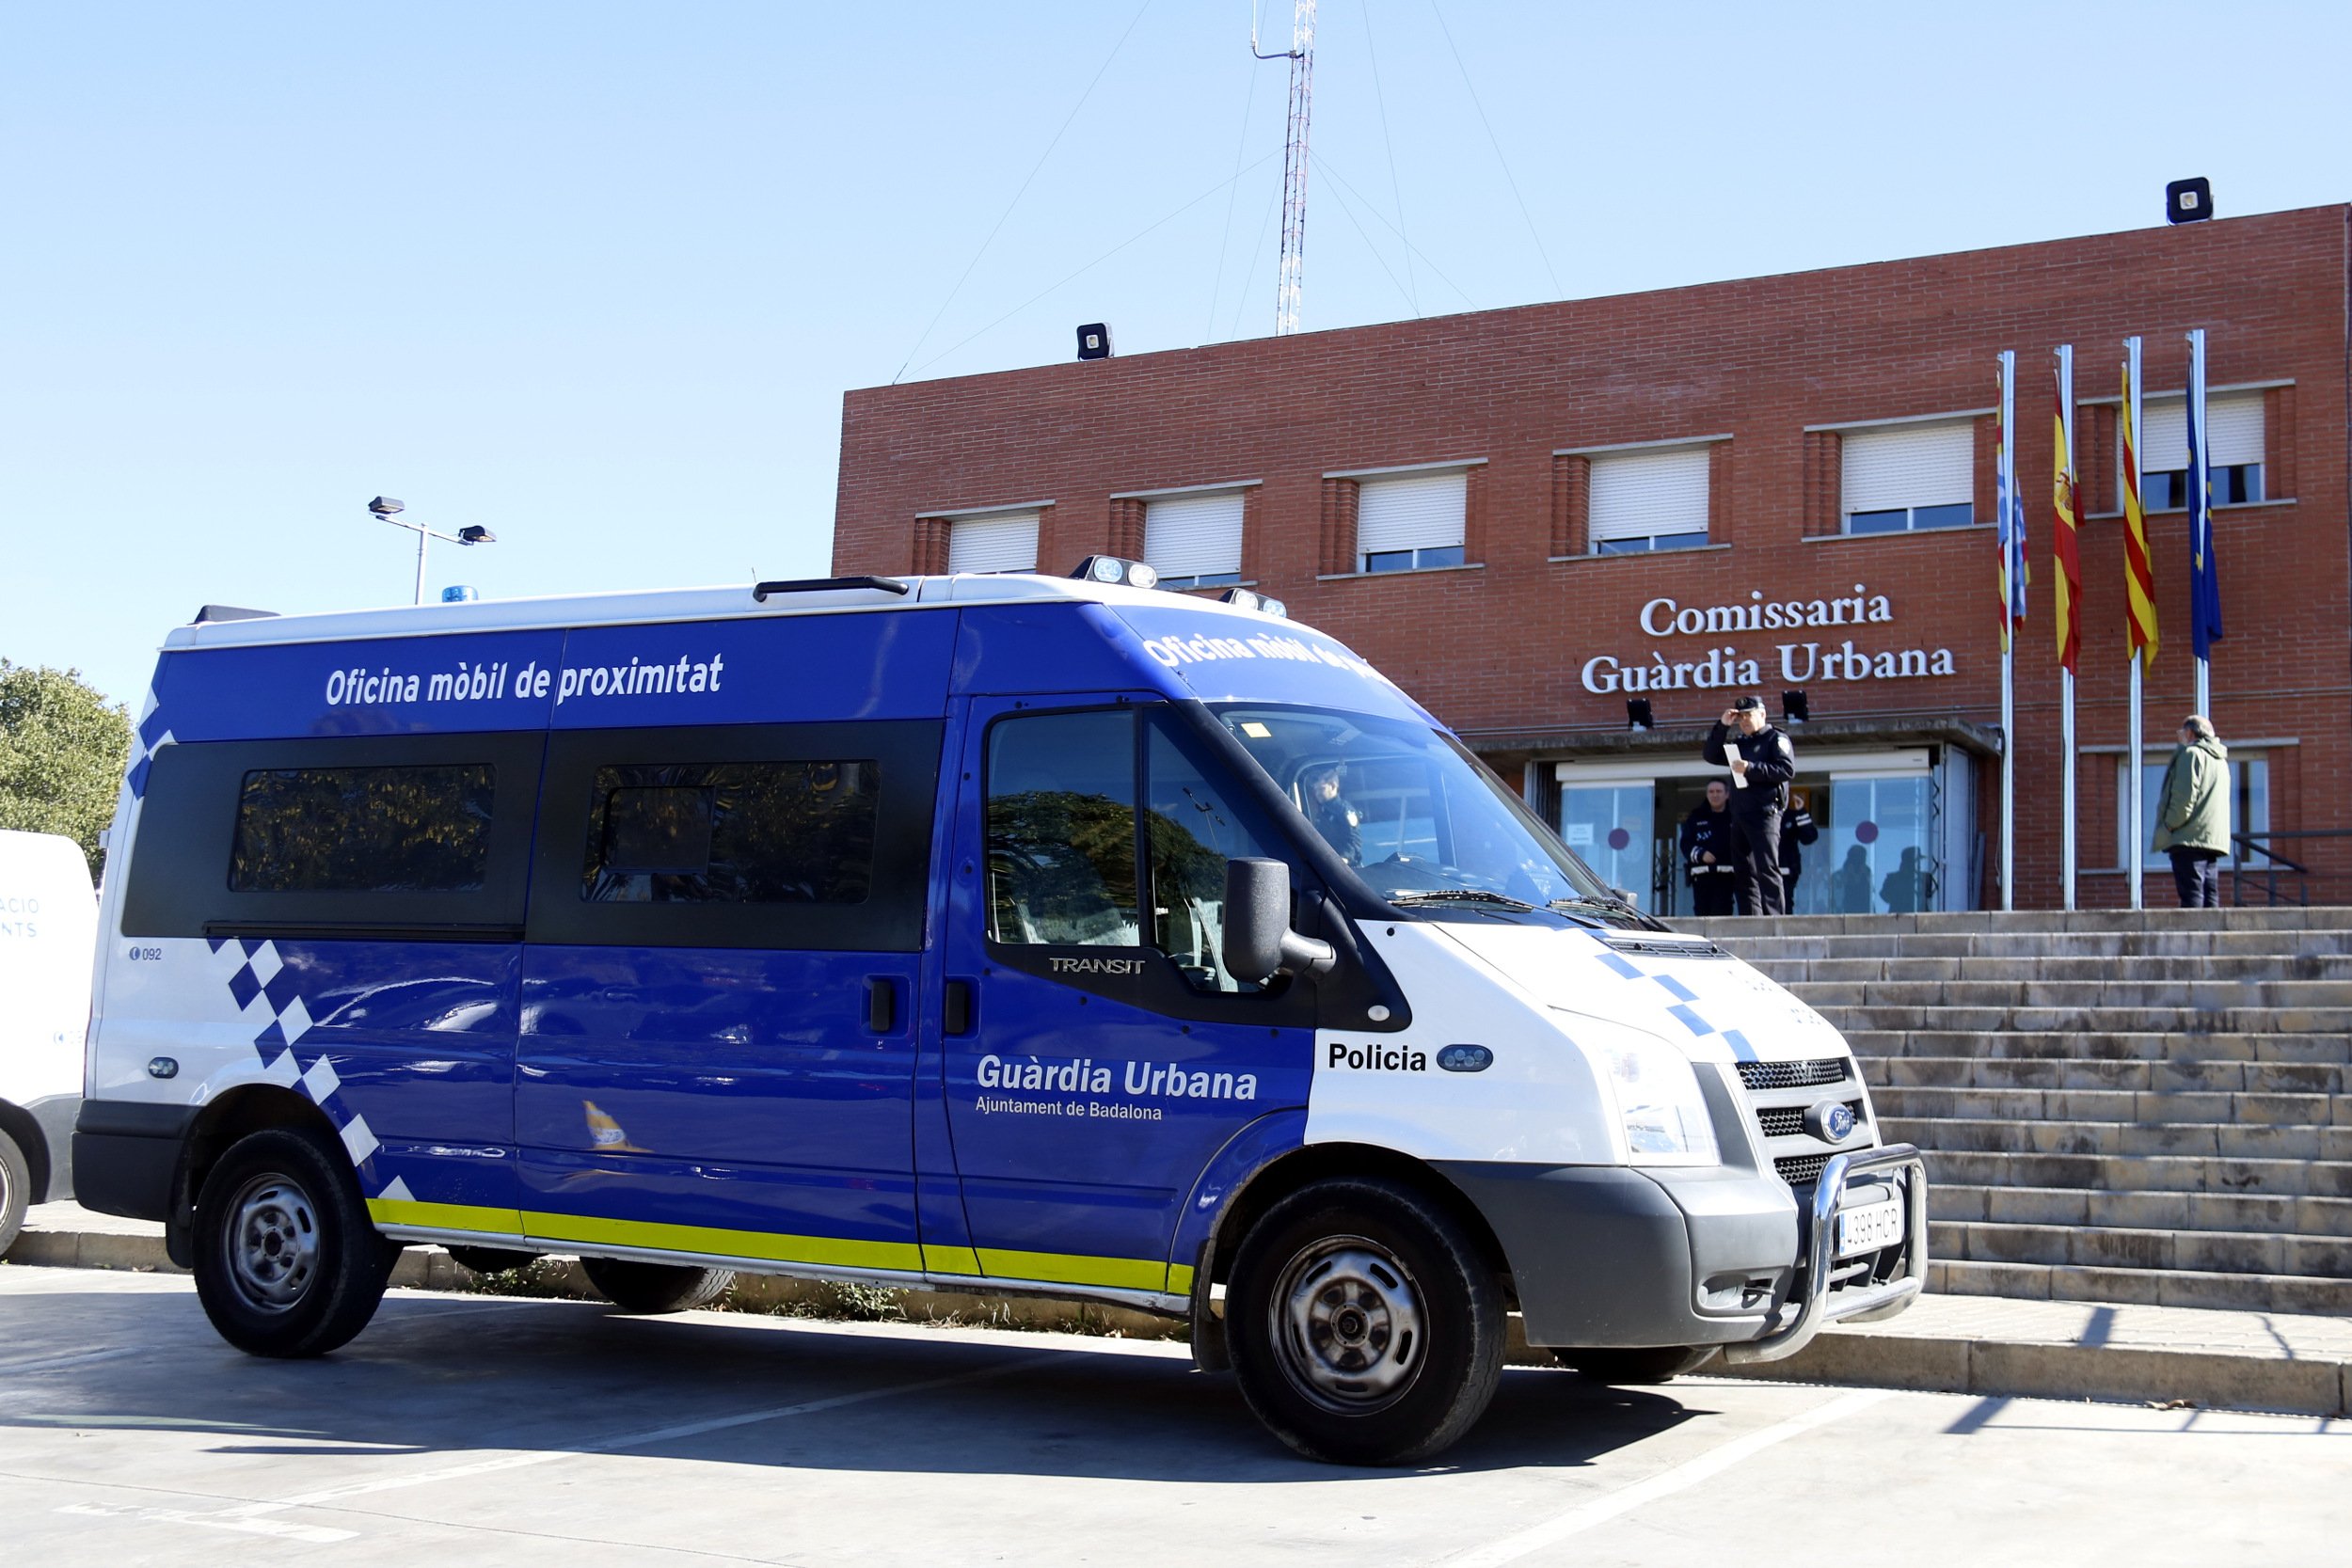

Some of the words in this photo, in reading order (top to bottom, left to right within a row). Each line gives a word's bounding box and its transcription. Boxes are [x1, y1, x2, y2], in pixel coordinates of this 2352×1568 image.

[1640, 583, 1894, 637] Comissaria
[1143, 633, 1255, 667] Oficina
[326, 666, 419, 705] Oficina
[427, 661, 508, 702] mòbil
[515, 660, 550, 699] de
[557, 653, 723, 706] proximitat
[1581, 646, 1762, 694] Guàrdia
[1775, 641, 1956, 683] Urbana
[142, 947, 162, 960] 092
[1049, 958, 1146, 974] TRANSIT
[1328, 1043, 1427, 1071] Policia
[977, 1054, 1112, 1094] Guàrdia
[1123, 1061, 1258, 1101] Urbana
[976, 1096, 1062, 1117] Ajuntament
[1066, 1101, 1085, 1116] de
[1089, 1102, 1163, 1121] Badalona
[1834, 1110, 1851, 1132] Ford
[1875, 1207, 1898, 1241] HCR
